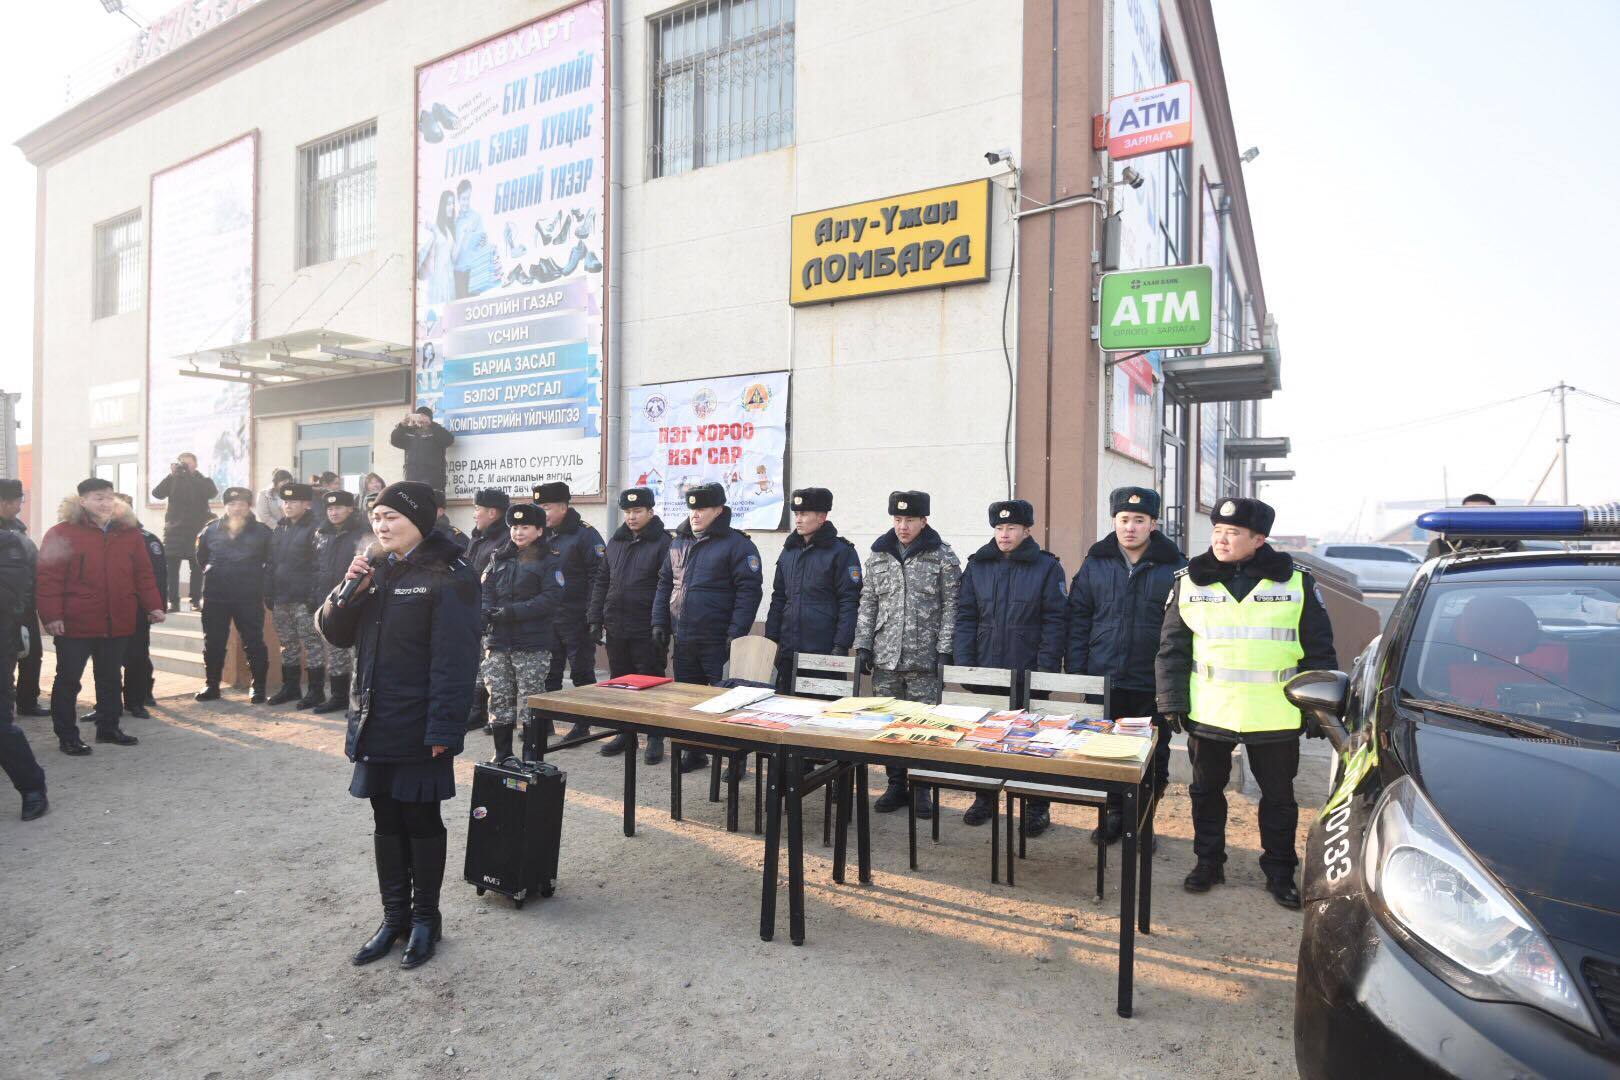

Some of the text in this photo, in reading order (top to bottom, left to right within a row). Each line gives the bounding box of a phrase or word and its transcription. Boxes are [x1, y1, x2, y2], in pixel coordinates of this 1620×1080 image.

[463, 14, 576, 79] ДАВХАРТ
[502, 77, 528, 116] БҮХ
[533, 49, 594, 106] ТӨРЛИЙН
[539, 103, 594, 151] ХУВЦАС
[1119, 98, 1180, 133] ATM
[550, 157, 594, 201] ҮНЭЭР
[802, 235, 971, 290] ЛОМБАРД
[465, 291, 563, 321] ЗООГИЙН ГАЗАР
[1110, 290, 1200, 327] ATM
[487, 325, 529, 345] ҮСЧИН
[473, 352, 556, 377] БАРИА ЗАСАЛ
[464, 381, 562, 405] БЭЛЭГ ДУРСГАЛ
[450, 410, 522, 432] КОМПЬЮТЕРИЙН
[659, 421, 754, 444] НЭГ ХОРОО
[446, 454, 584, 473] ДӨР ДАЯН АВТО СУРГУУЛЬ
[668, 446, 743, 466] НЭГ САР
[397, 491, 418, 509] POLICE
